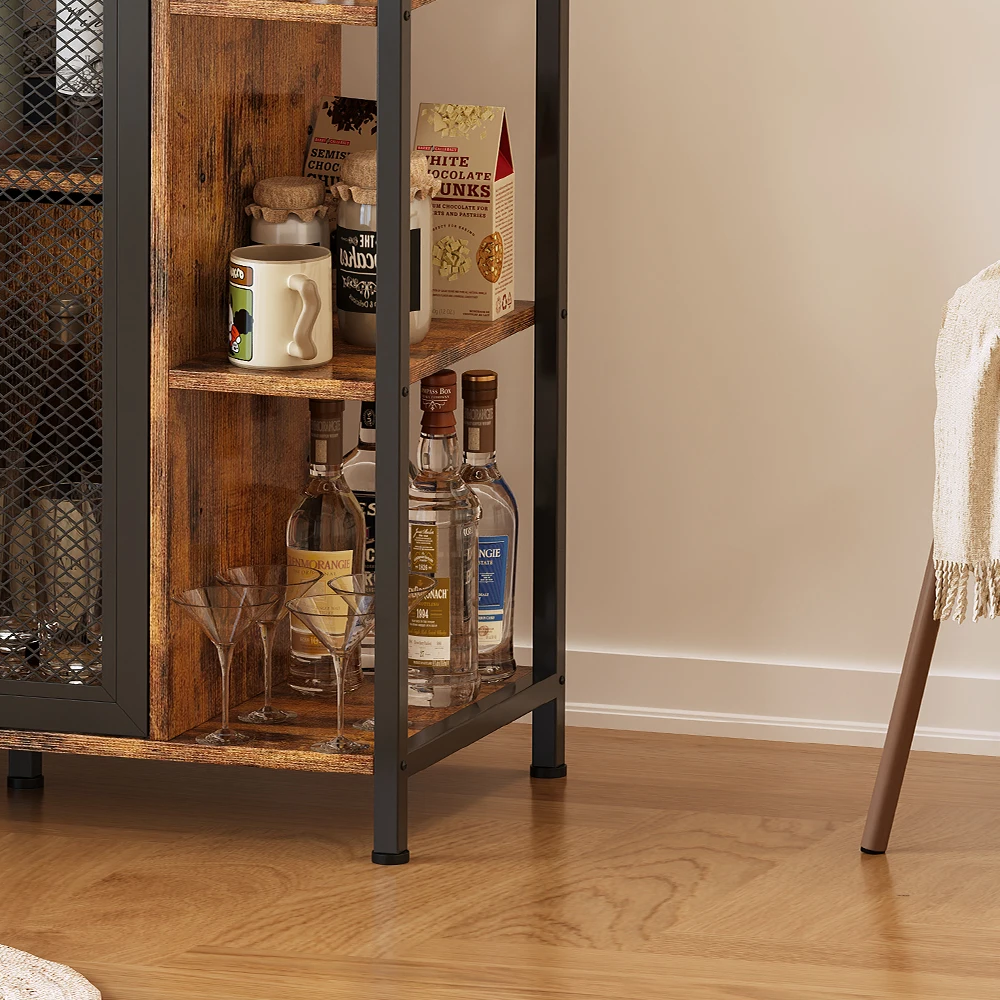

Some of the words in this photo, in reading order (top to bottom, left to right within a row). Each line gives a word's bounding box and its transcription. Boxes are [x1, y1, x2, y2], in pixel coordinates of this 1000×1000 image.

[310, 148, 350, 160] SEMIS
[307, 160, 340, 172] CHOC
[428, 169, 492, 181] OCOLATE
[440, 182, 491, 198] UNKS
[441, 203, 476, 211] CHOCOLATE
[478, 548, 501, 558] NGIE
[288, 556, 350, 570] LENMORANGIE
